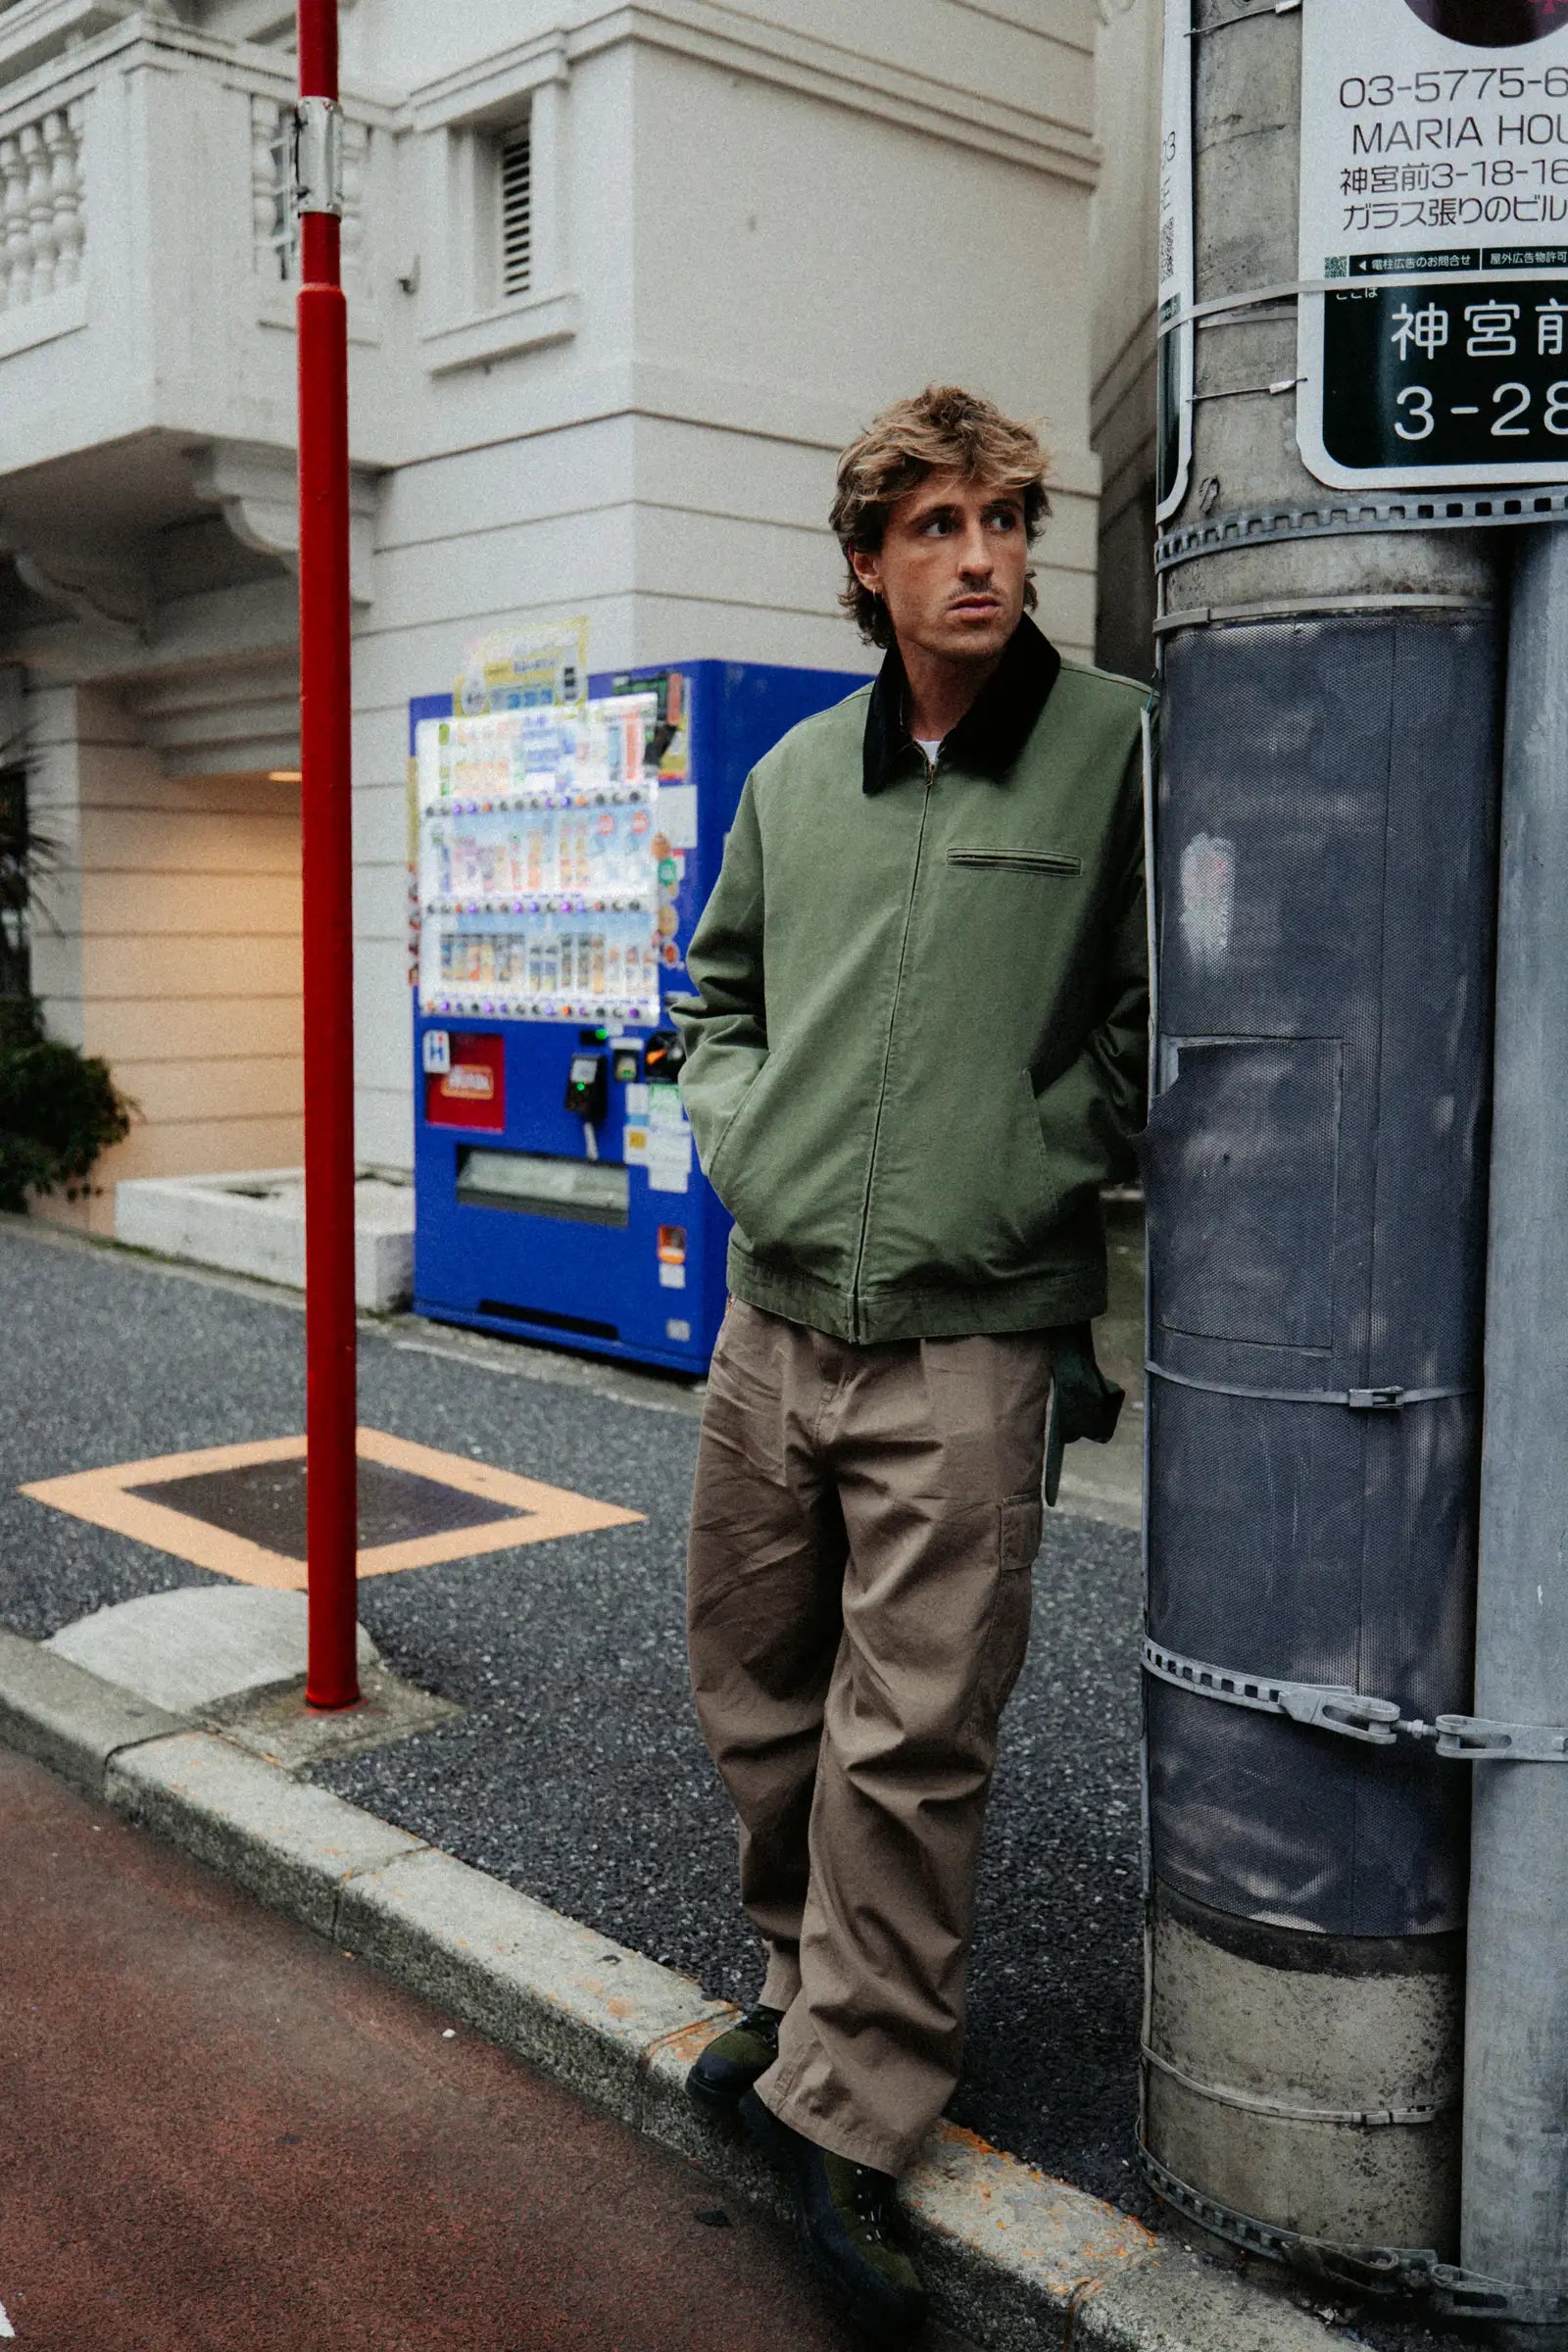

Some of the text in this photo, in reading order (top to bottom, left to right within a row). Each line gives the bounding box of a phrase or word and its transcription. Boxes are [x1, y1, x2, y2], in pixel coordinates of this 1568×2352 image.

[1339, 67, 1568, 109] 03-5775-6
[1352, 116, 1484, 155] MARIA
[1340, 159, 1568, 196] 神宮前3-18-16
[1343, 194, 1568, 231] ガラス張りのビル
[1371, 254, 1471, 270] 電柱広告のお問合せ
[1490, 251, 1568, 265] 屋外広告物許可
[1391, 297, 1568, 362] 神宮前
[1395, 380, 1568, 441] 3-28
